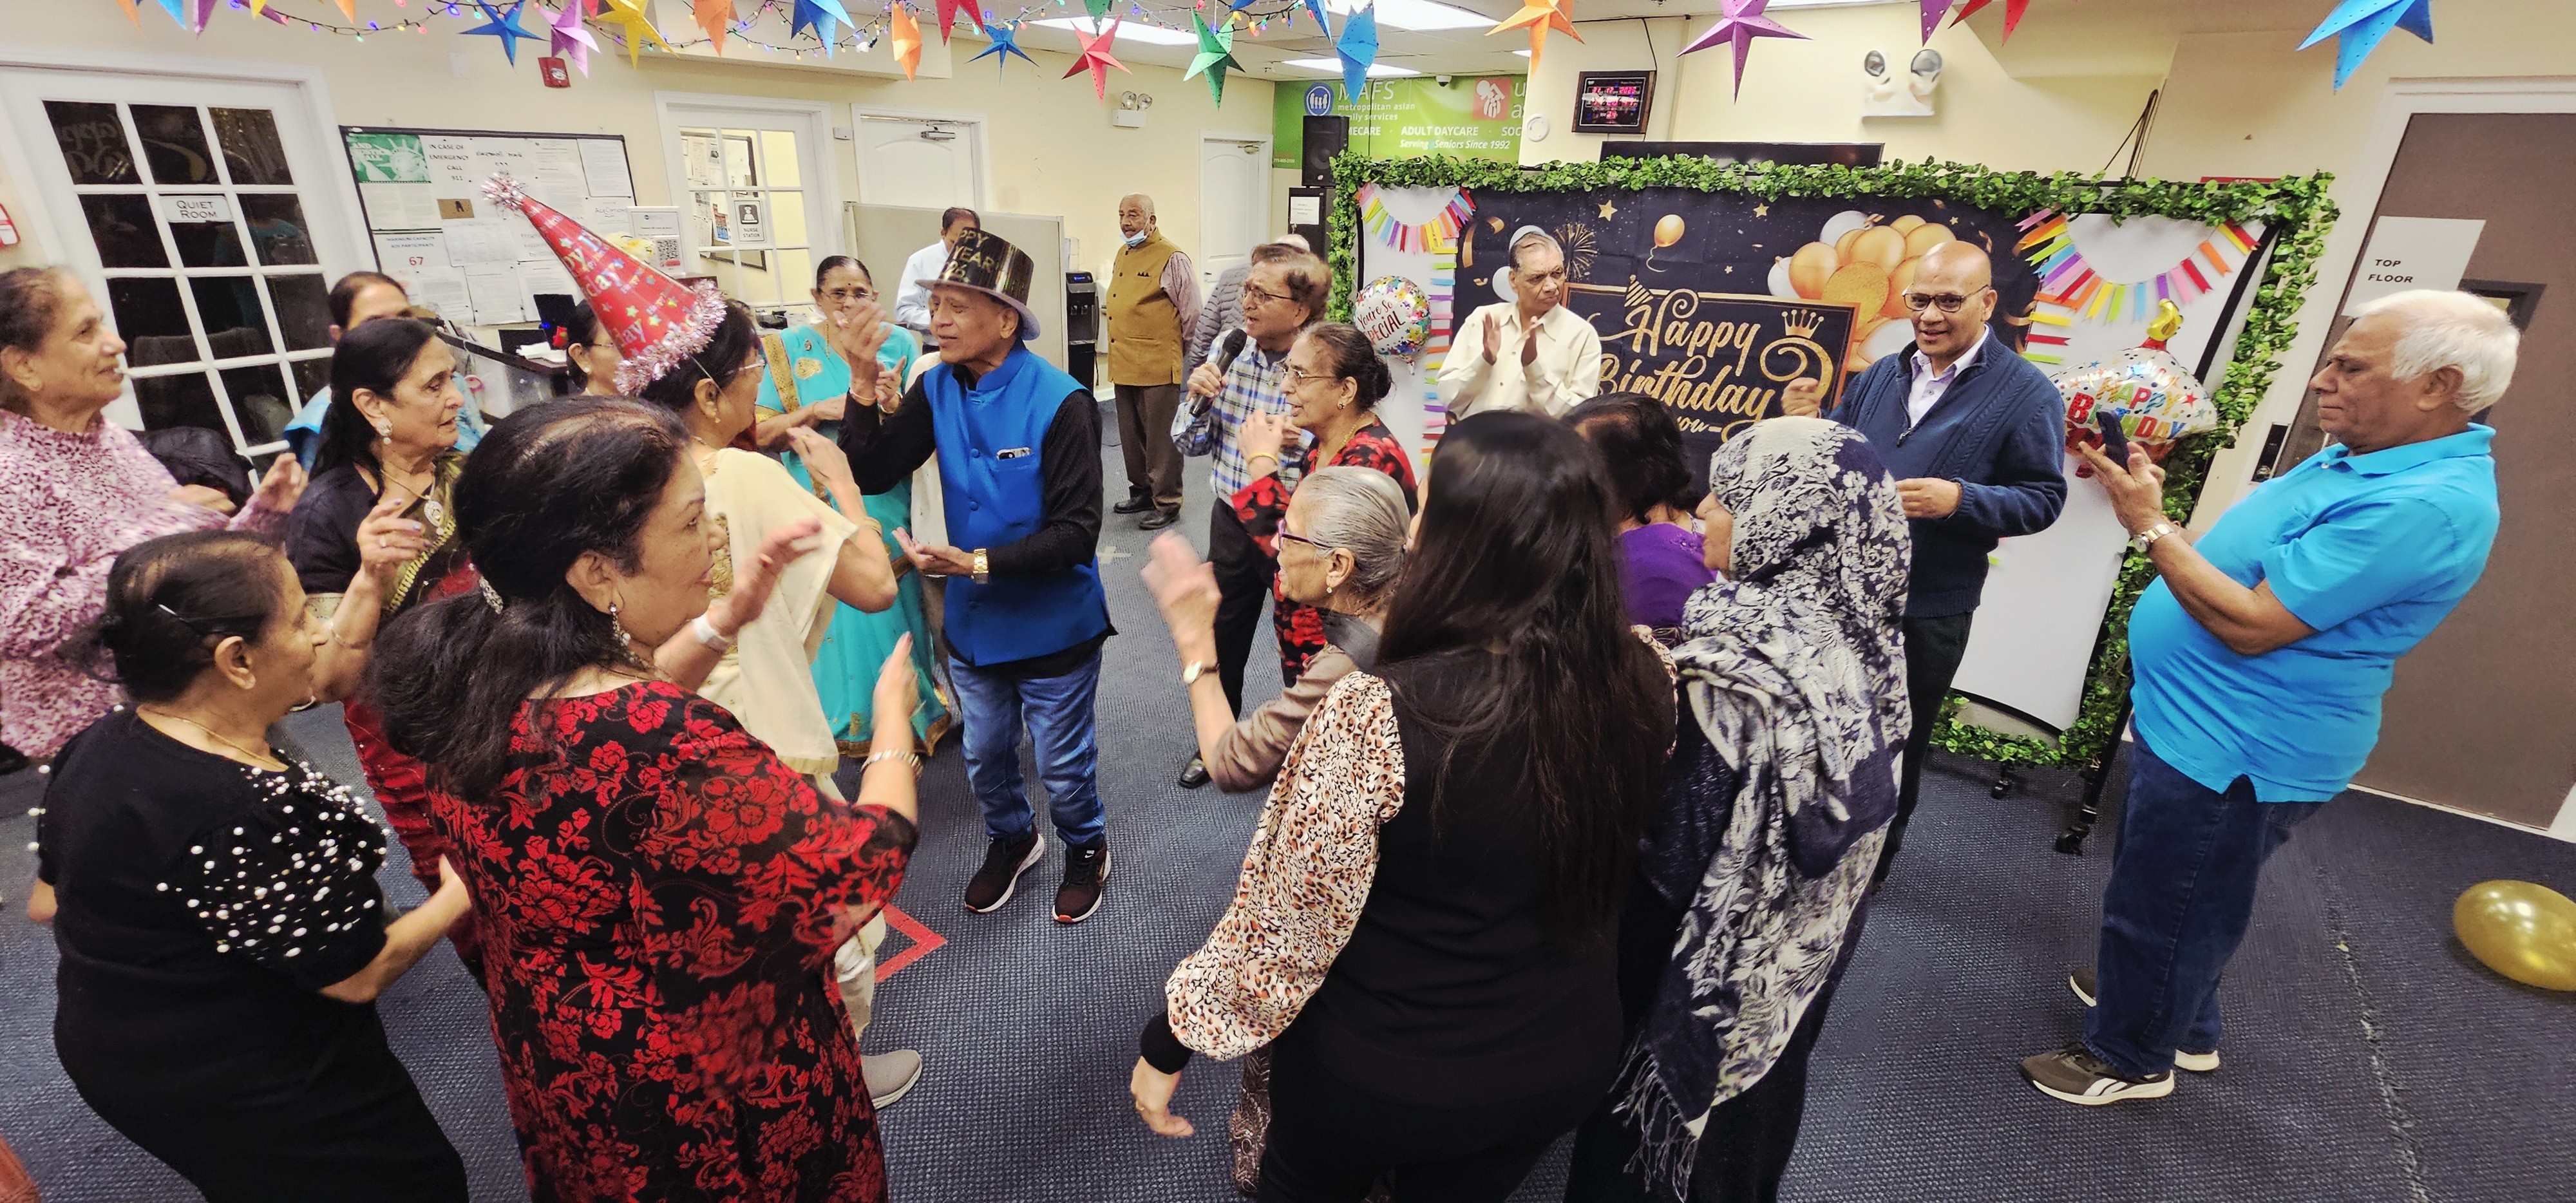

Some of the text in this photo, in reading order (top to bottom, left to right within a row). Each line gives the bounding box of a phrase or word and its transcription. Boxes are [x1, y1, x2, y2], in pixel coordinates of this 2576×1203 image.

[1338, 81, 1395, 100] MAFS
[1338, 103, 1391, 112] metropolitan
[1401, 126, 1433, 136] ADULT
[1434, 126, 1479, 137] DAYCARE
[1501, 126, 1522, 137] SOC
[1399, 139, 1511, 150] Serving Seniors Since 1992
[176, 200, 214, 209] QUIET
[180, 210, 218, 218] ROOM
[409, 256, 424, 266] 67
[2375, 259, 2401, 267] TOP
[2368, 274, 2414, 283] FLOOR
[1381, 299, 1393, 313] So
[1363, 310, 1406, 346] PECIAL
[1599, 289, 1761, 377] Happy
[1599, 354, 1776, 425] Birthday
[2096, 377, 2181, 416] HAPPY
